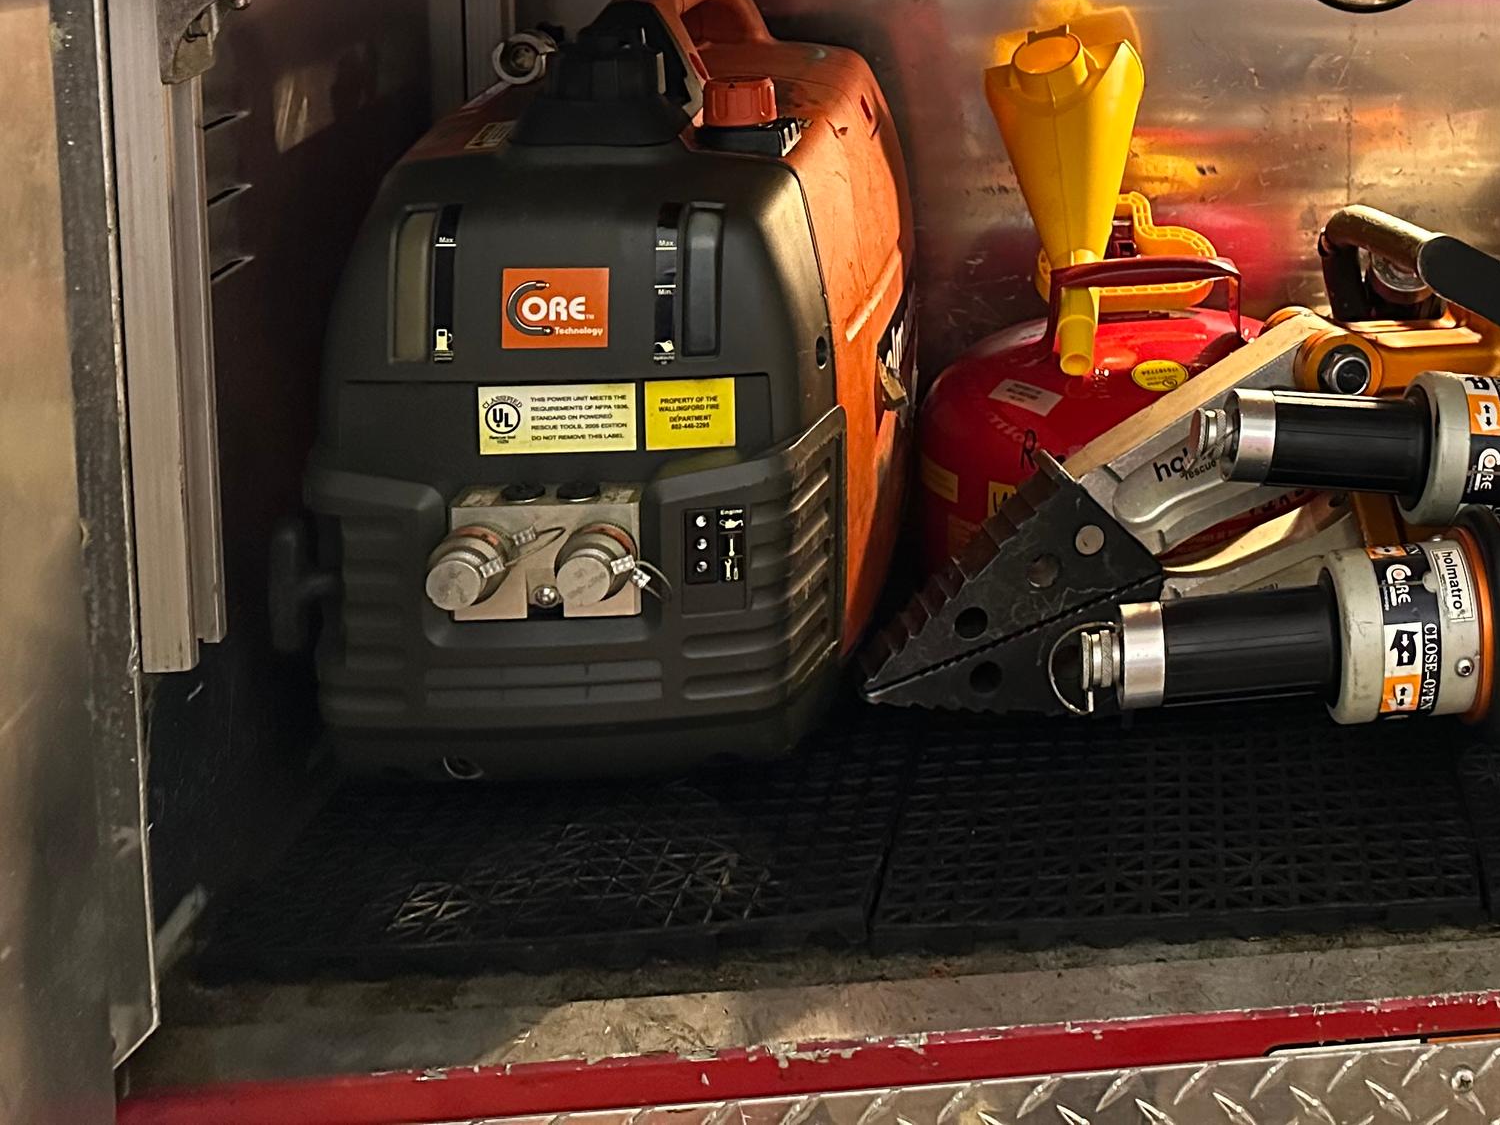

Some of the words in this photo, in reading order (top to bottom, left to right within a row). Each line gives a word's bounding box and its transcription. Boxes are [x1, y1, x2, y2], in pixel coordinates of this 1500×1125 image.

[506, 281, 586, 337] CORE
[554, 327, 603, 337] Technology
[482, 396, 523, 409] CLASSIFIED
[659, 404, 705, 412] WALLINGFORD
[493, 408, 513, 428] UL
[721, 508, 743, 516] Engine
[1442, 552, 1464, 610] holmatro
